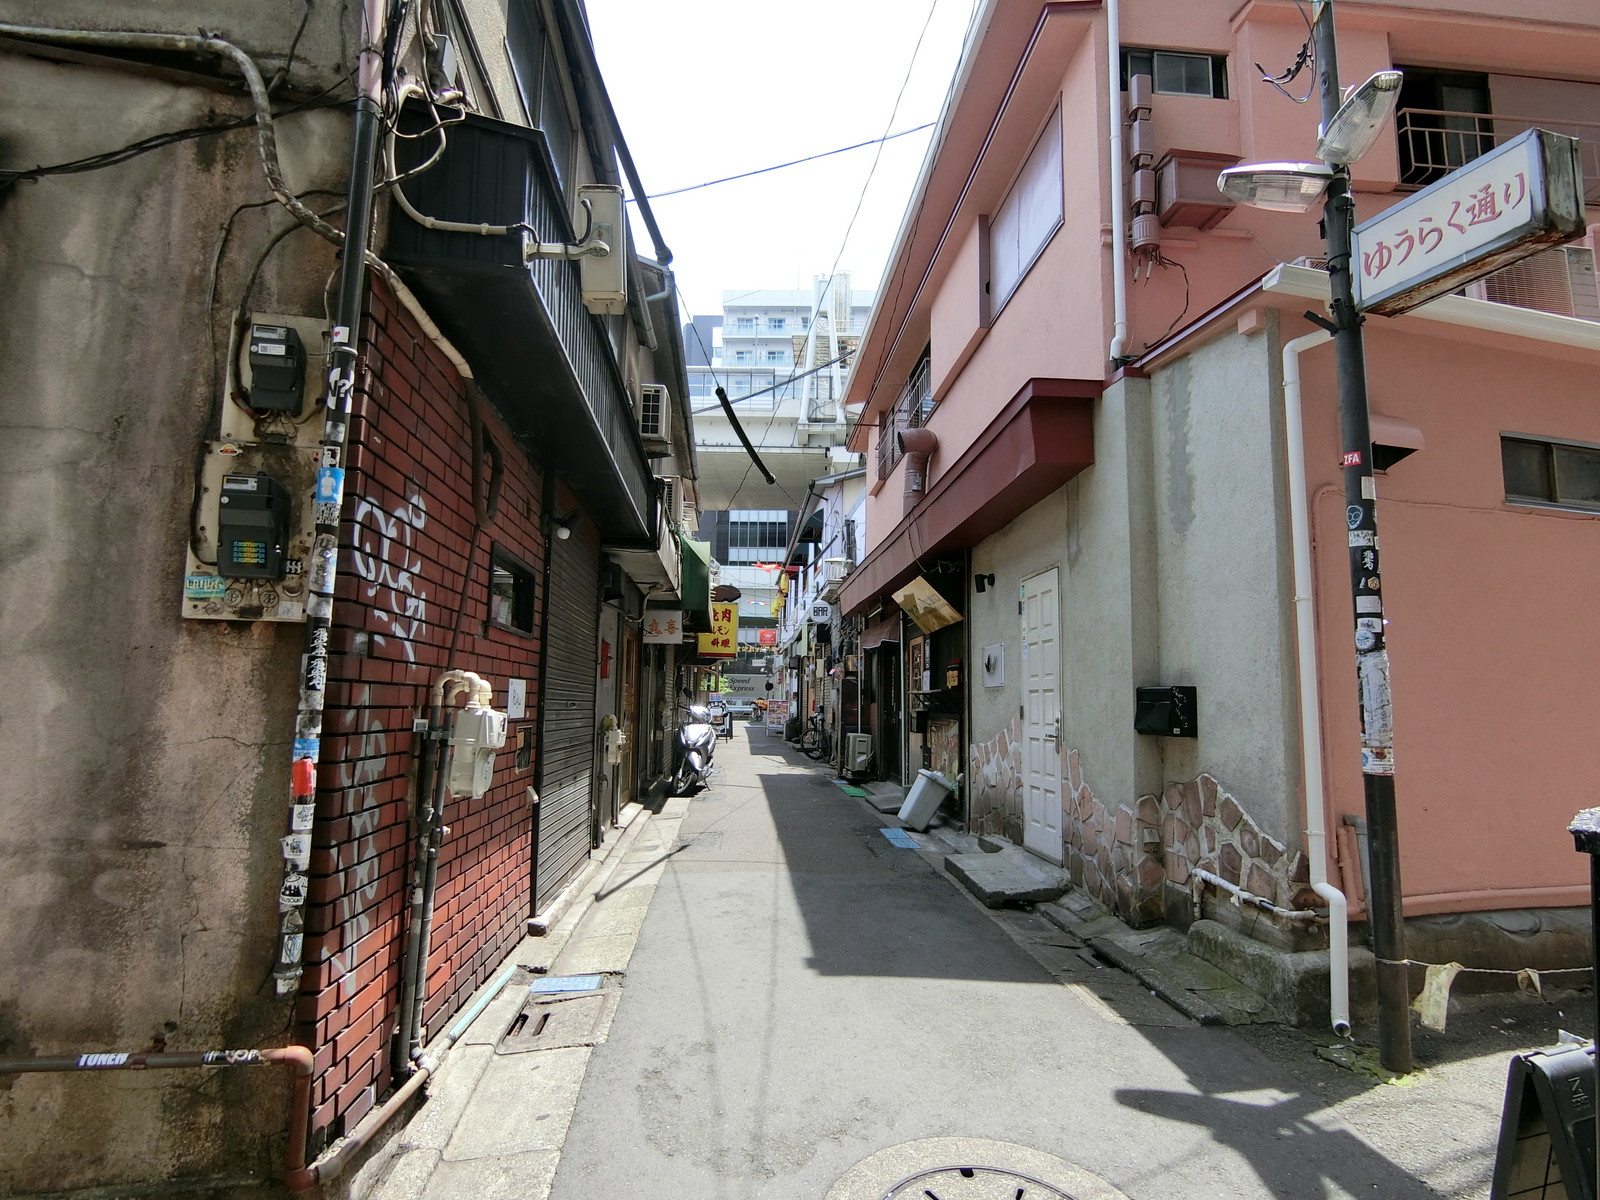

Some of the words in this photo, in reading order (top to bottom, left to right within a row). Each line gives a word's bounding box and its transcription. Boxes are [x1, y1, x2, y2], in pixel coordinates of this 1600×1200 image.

[1363, 172, 1525, 280] ゆうらく通り
[1343, 453, 1359, 465] ZFA
[813, 606, 828, 617] BAR
[710, 637, 731, 648] 料理
[729, 677, 751, 686] Speed
